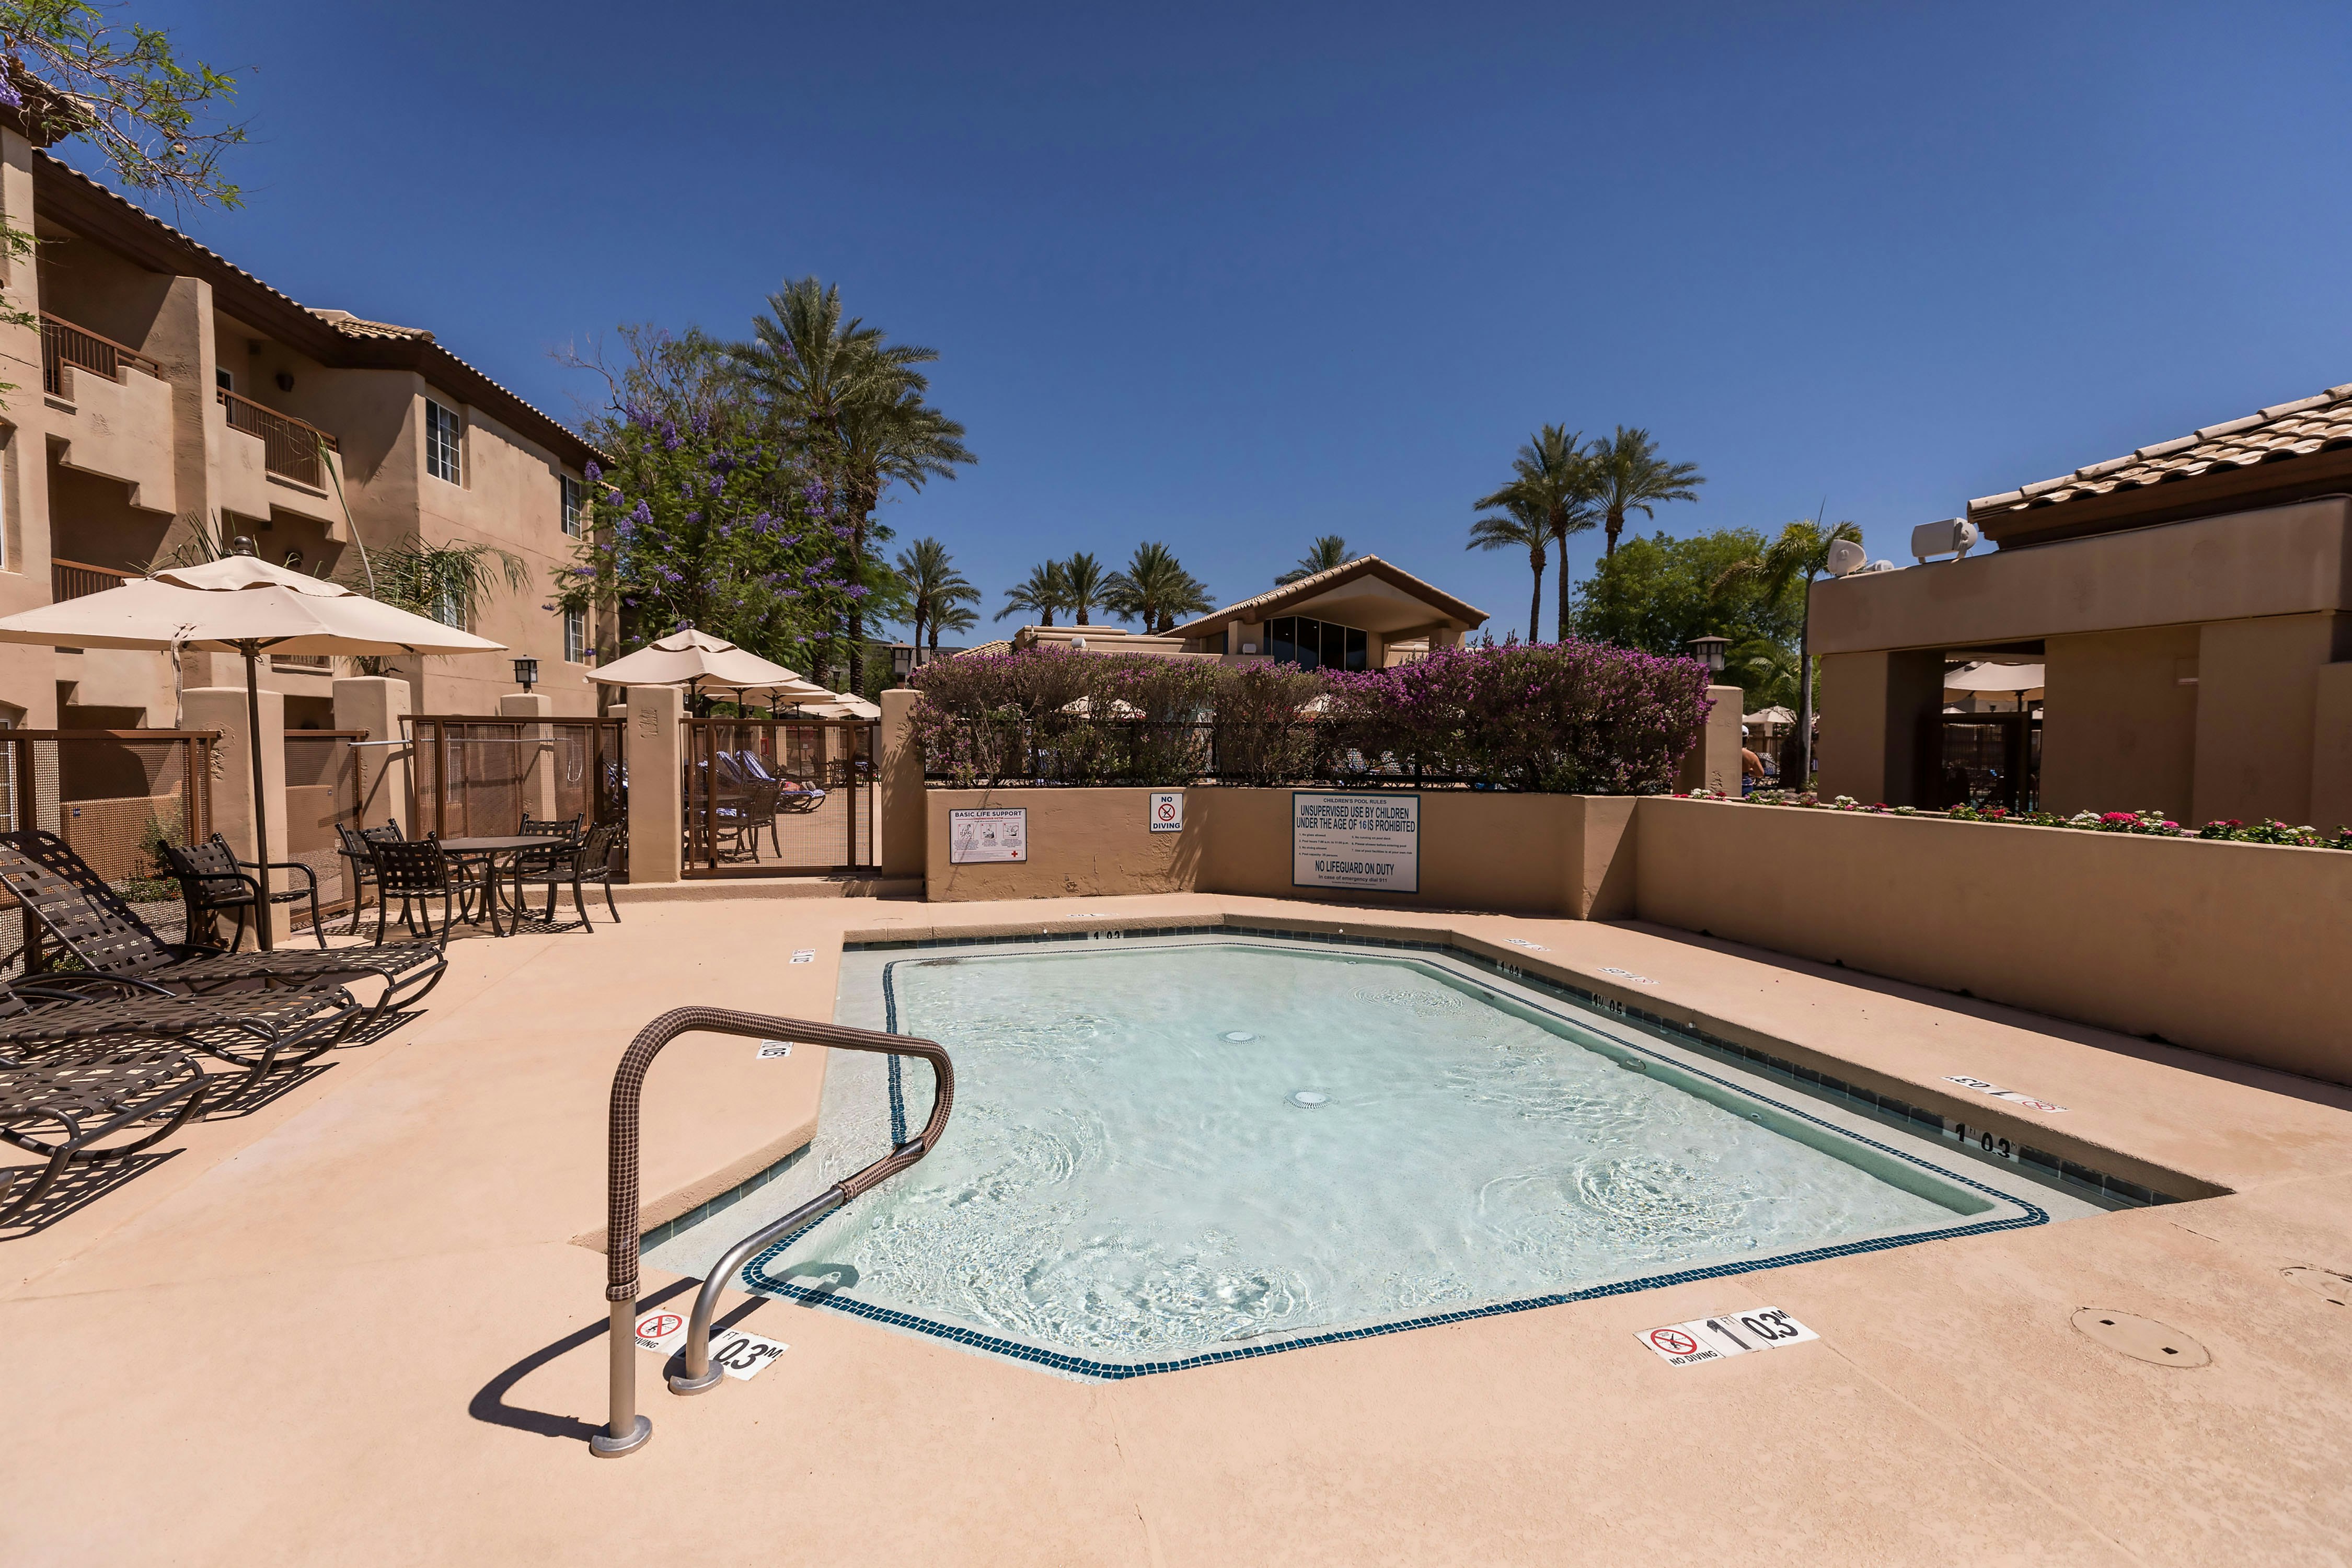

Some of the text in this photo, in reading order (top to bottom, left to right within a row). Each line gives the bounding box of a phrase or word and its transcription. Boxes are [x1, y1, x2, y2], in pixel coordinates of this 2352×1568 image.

[1300, 804, 1409, 819] UNSUPERVISED USE BY CHILDREN
[1296, 817, 1415, 832] UNDER THE AGE OF 16 IS PROHIBITED
[1315, 860, 1394, 875] NO LIFEGUARD ON DUTY
[1955, 1122, 1965, 1143] 1
[1721, 1317, 1735, 1325] FT
[722, 1331, 739, 1341] FT
[1707, 1319, 1752, 1350] 1
[1684, 1351, 1718, 1362] DIVING
